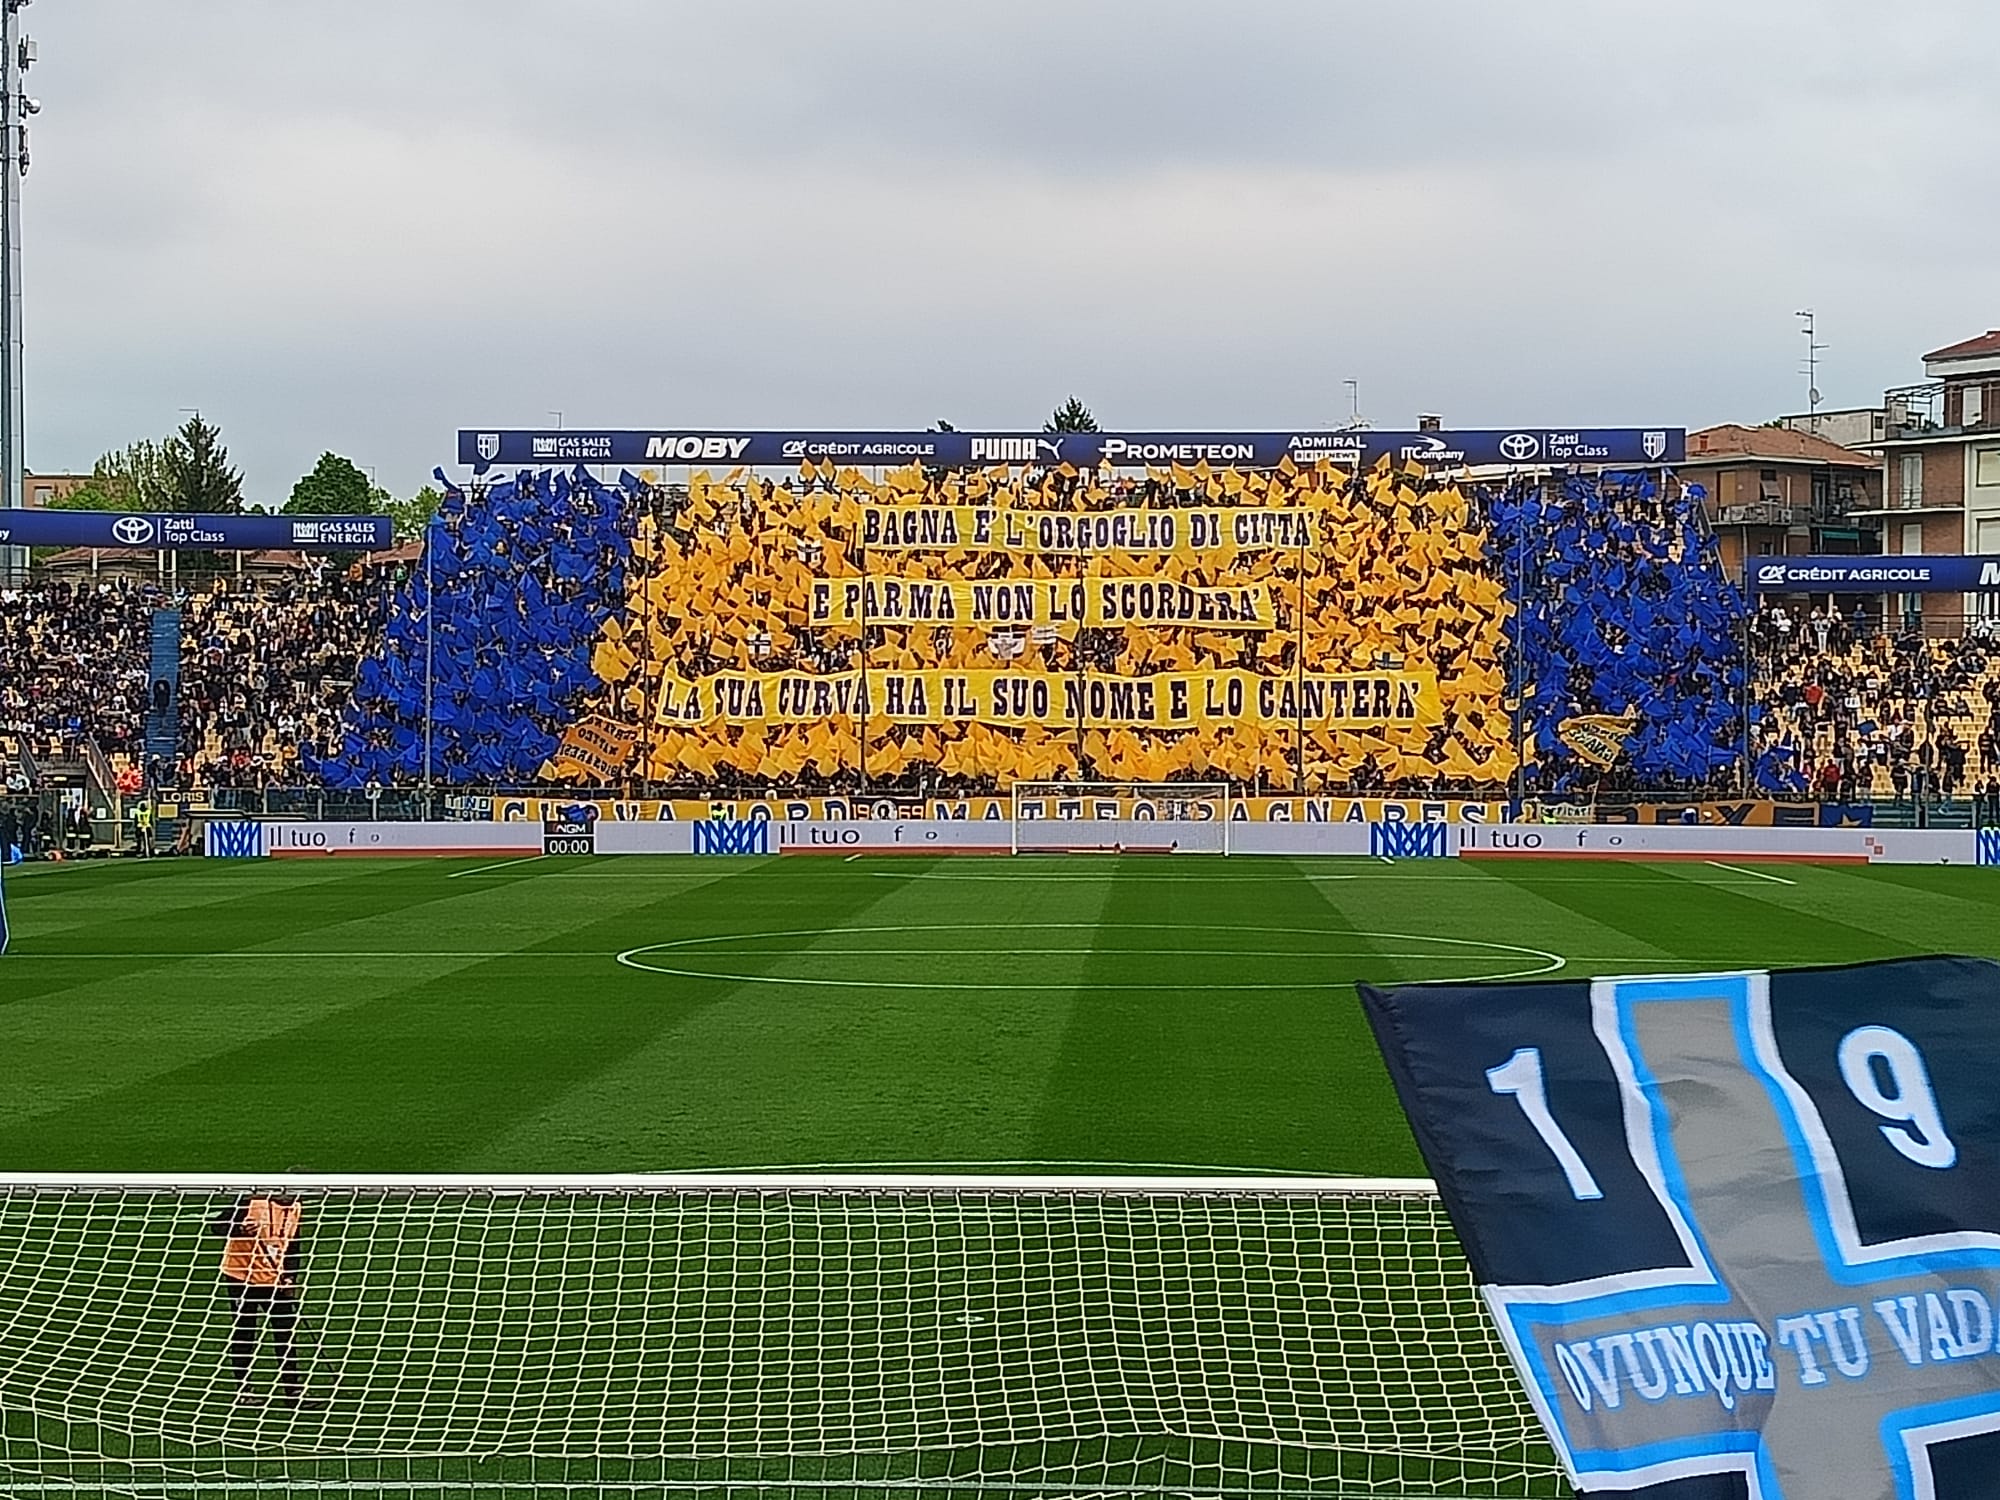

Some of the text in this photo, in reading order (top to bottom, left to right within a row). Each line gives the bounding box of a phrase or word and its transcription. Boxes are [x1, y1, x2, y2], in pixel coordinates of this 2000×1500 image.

[559, 438, 611, 447] GAS SALES
[1288, 435, 1367, 449] ADMIRAL
[1549, 433, 1579, 445] Zatti
[559, 448, 611, 458] ENERGIA
[646, 437, 752, 458] MOBY
[809, 441, 860, 455] CRÉDIT
[863, 442, 935, 455] AGRICOLE
[971, 438, 1036, 460] PUMA
[1099, 439, 1254, 459] PROMETEON
[1401, 446, 1464, 461] ITCompany
[1550, 446, 1608, 458] Top Class
[164, 518, 195, 530] Zatti
[319, 523, 376, 533] GAS SALES
[864, 509, 1315, 550] BAGNA E' L'ORGOGLIO DI CITTA'
[165, 531, 225, 544] Top Class
[319, 534, 376, 544] ENERGIA
[1787, 567, 1847, 581] CRÉDIT
[1849, 569, 1930, 581] AGRICOLE
[813, 582, 1260, 621] E PARMA NON LO SCORDERA'
[662, 677, 1419, 720] LA SUA CURVA HA IL SUO NOME E LO CANTERA'
[162, 790, 205, 804] LORIS
[291, 830, 326, 847] tuo
[809, 827, 860, 844] tuo
[1490, 830, 1542, 848] tuo
[549, 840, 589, 854] 00:00
[1838, 1025, 1957, 1169] 9
[1554, 1288, 2000, 1411] OVUNQUE TU VAD
